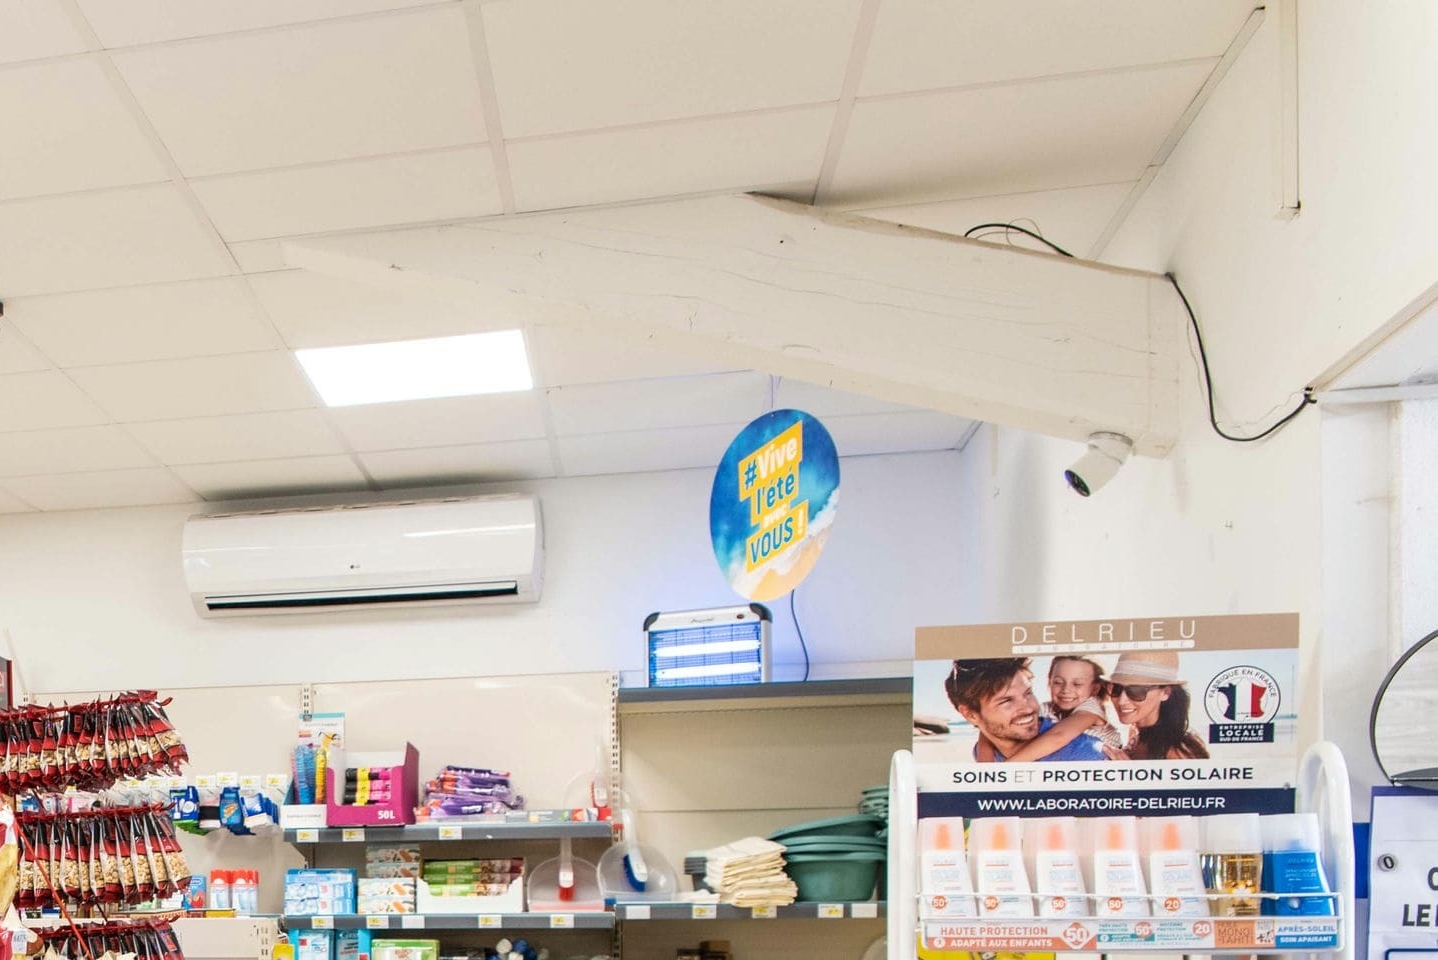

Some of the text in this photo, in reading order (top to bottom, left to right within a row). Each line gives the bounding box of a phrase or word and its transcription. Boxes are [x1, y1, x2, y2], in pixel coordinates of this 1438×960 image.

[744, 437, 797, 490] #Vive
[756, 467, 794, 514] l'été
[751, 508, 804, 564] VOUS !
[1012, 620, 1196, 645] DELRIEU
[953, 767, 1254, 784] SOINS ET PROTECTION SOLAIRE
[978, 796, 1226, 812] WWW.LABORATOIRE-DELRIEU.FR
[378, 810, 395, 820] 50L
[1166, 901, 1179, 909] 20
[1402, 904, 1430, 927] LE
[941, 927, 1048, 935] HAUTE PROTECTION
[1195, 924, 1210, 934] 20
[1278, 924, 1336, 933] APRÈS-SOLEIL
[951, 937, 1052, 947] ADAPTÉ AUX ENFANTS
